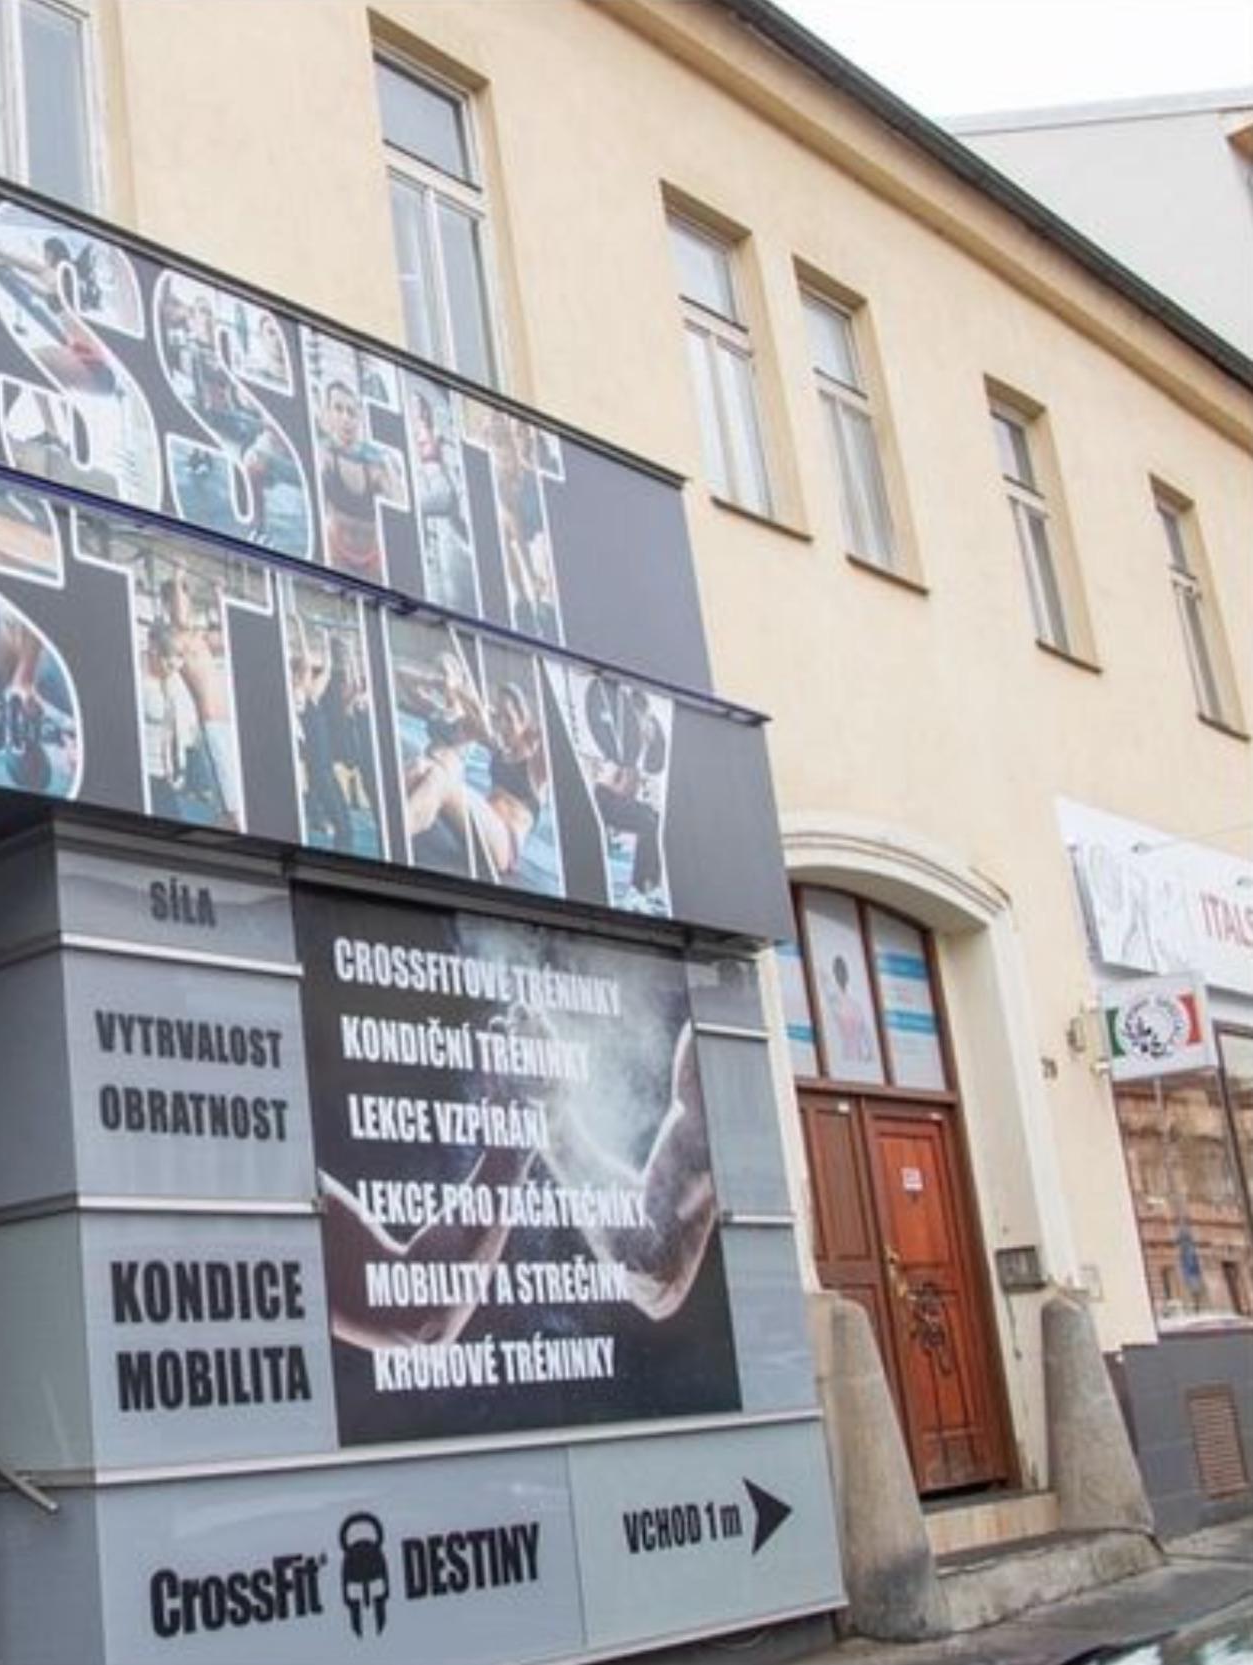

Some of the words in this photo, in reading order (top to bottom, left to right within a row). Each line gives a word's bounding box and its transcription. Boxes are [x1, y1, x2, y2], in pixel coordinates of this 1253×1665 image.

[150, 878, 216, 928] SÍLA
[511, 962, 621, 1016] TRÉNINKY
[95, 1010, 282, 1069] VYTRVALOST
[340, 1016, 474, 1070] KONDIČNÍ
[99, 1084, 288, 1141] OBRATNOST
[349, 1093, 432, 1143] LEKCE
[358, 1180, 437, 1225] LEKCE
[441, 1183, 493, 1226] PRO
[497, 1180, 647, 1227] ZAČÁTEČNÍKY
[110, 1260, 305, 1324] KONDICE
[366, 1262, 491, 1307] MOBILITY
[496, 1263, 514, 1305] A
[116, 1346, 312, 1412] MOBILITA
[373, 1334, 498, 1391] KRUHOVÉ
[501, 1332, 615, 1388] TRÉNINKY
[623, 1504, 701, 1554] VCHOD
[704, 1501, 717, 1540] 1
[720, 1503, 742, 1538] m
[400, 1521, 540, 1600] DESTINY
